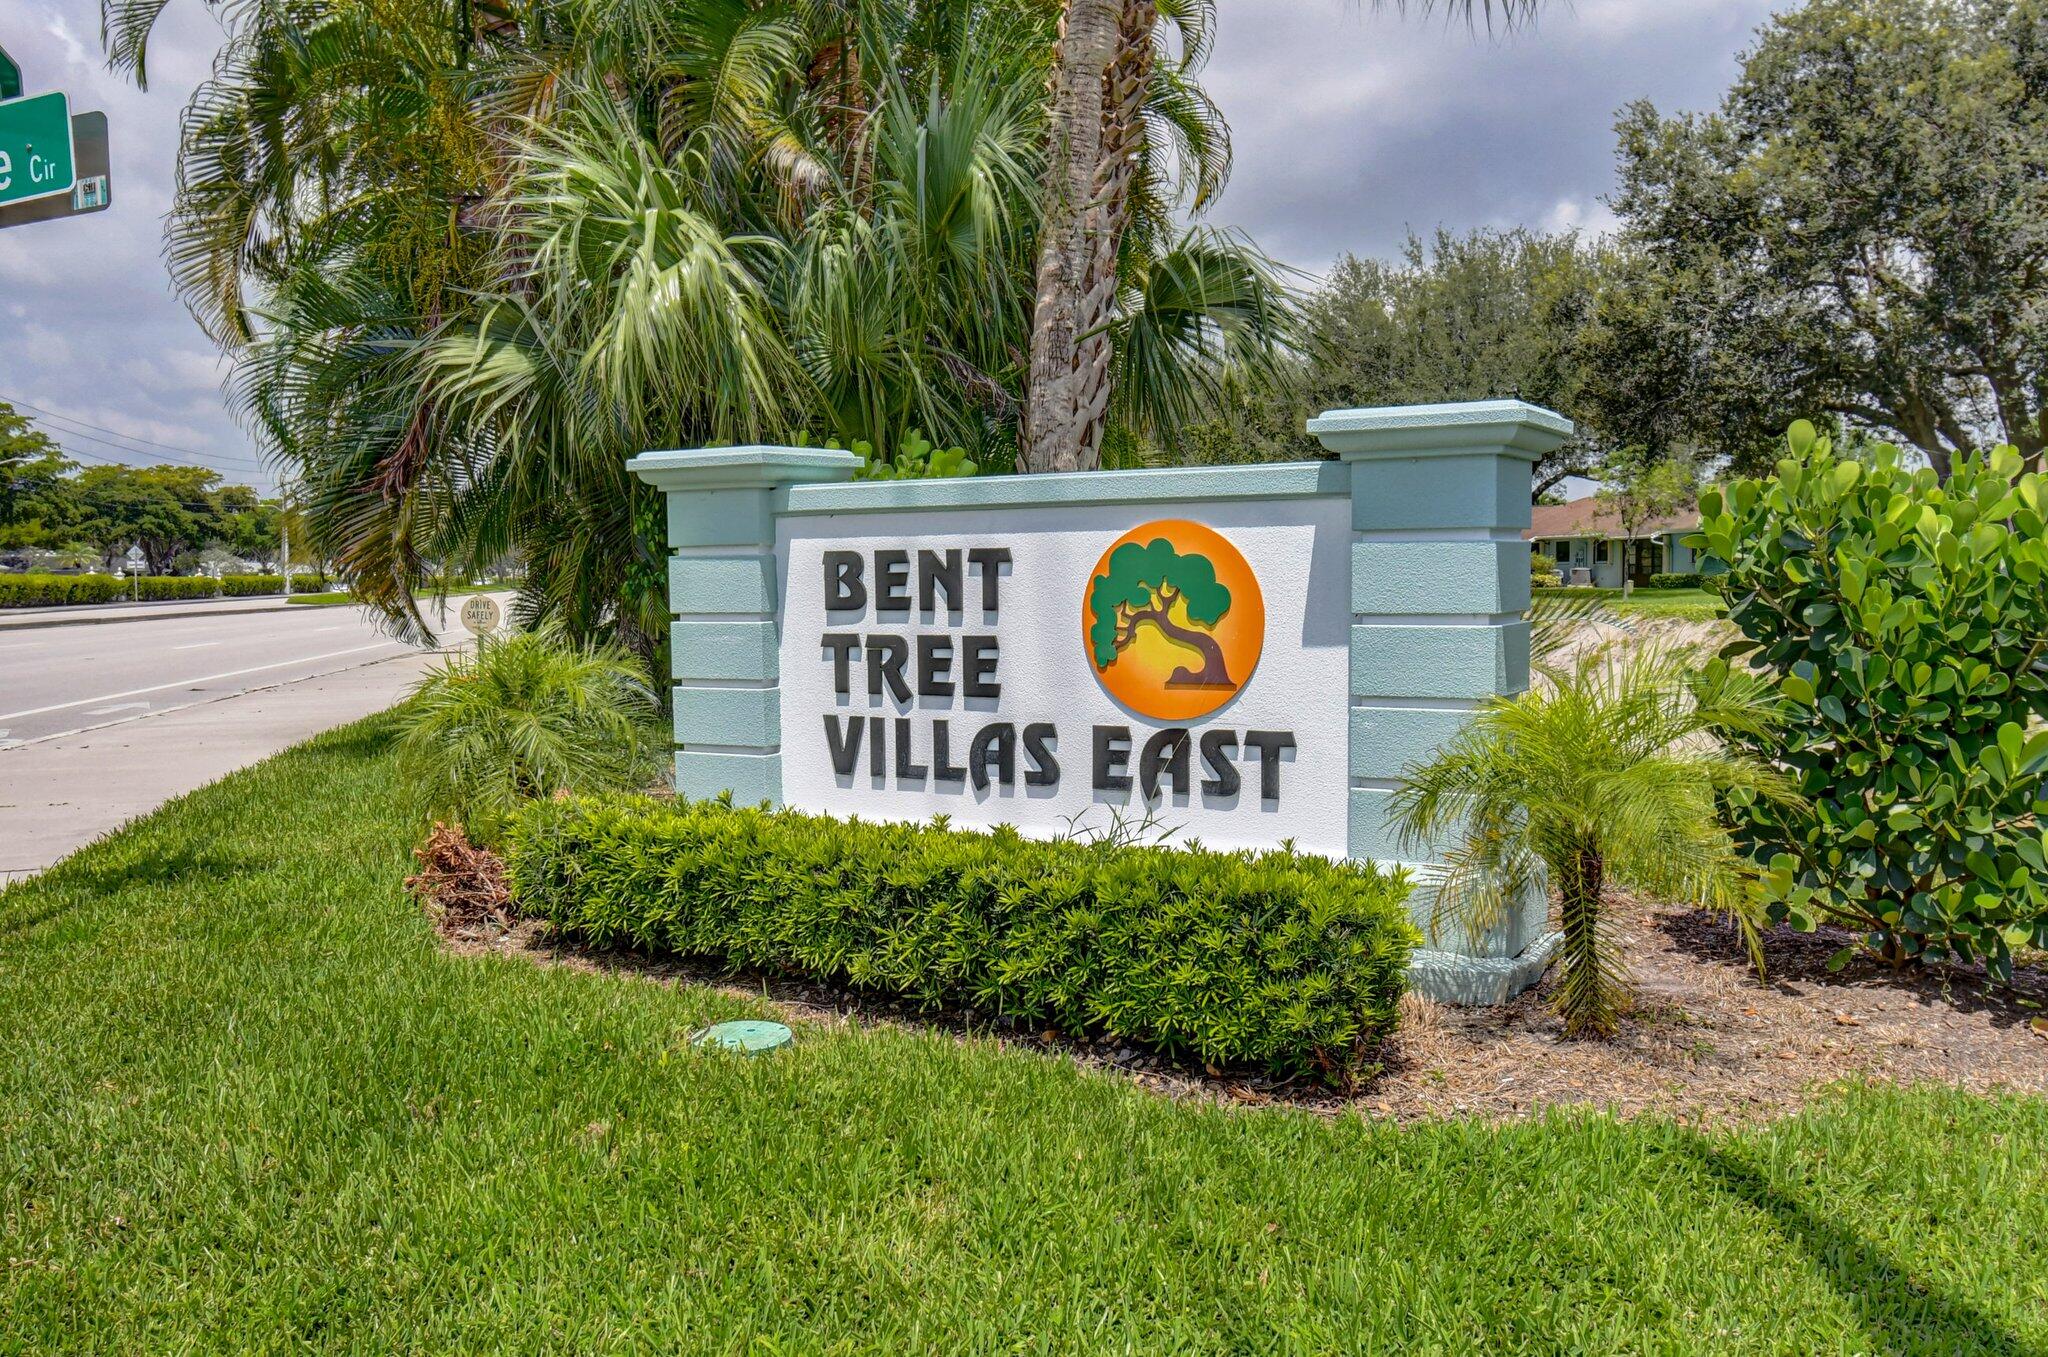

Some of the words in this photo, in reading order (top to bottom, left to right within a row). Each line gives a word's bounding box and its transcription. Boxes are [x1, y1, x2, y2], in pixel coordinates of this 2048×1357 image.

[30, 154, 56, 183] Cir
[822, 547, 1013, 611] BENT
[467, 610, 494, 620] SAFELY
[470, 600, 491, 610] DRIVE
[821, 633, 1001, 704] TREE
[823, 714, 1060, 791] VILLAS
[1092, 725, 1297, 800] EAST
